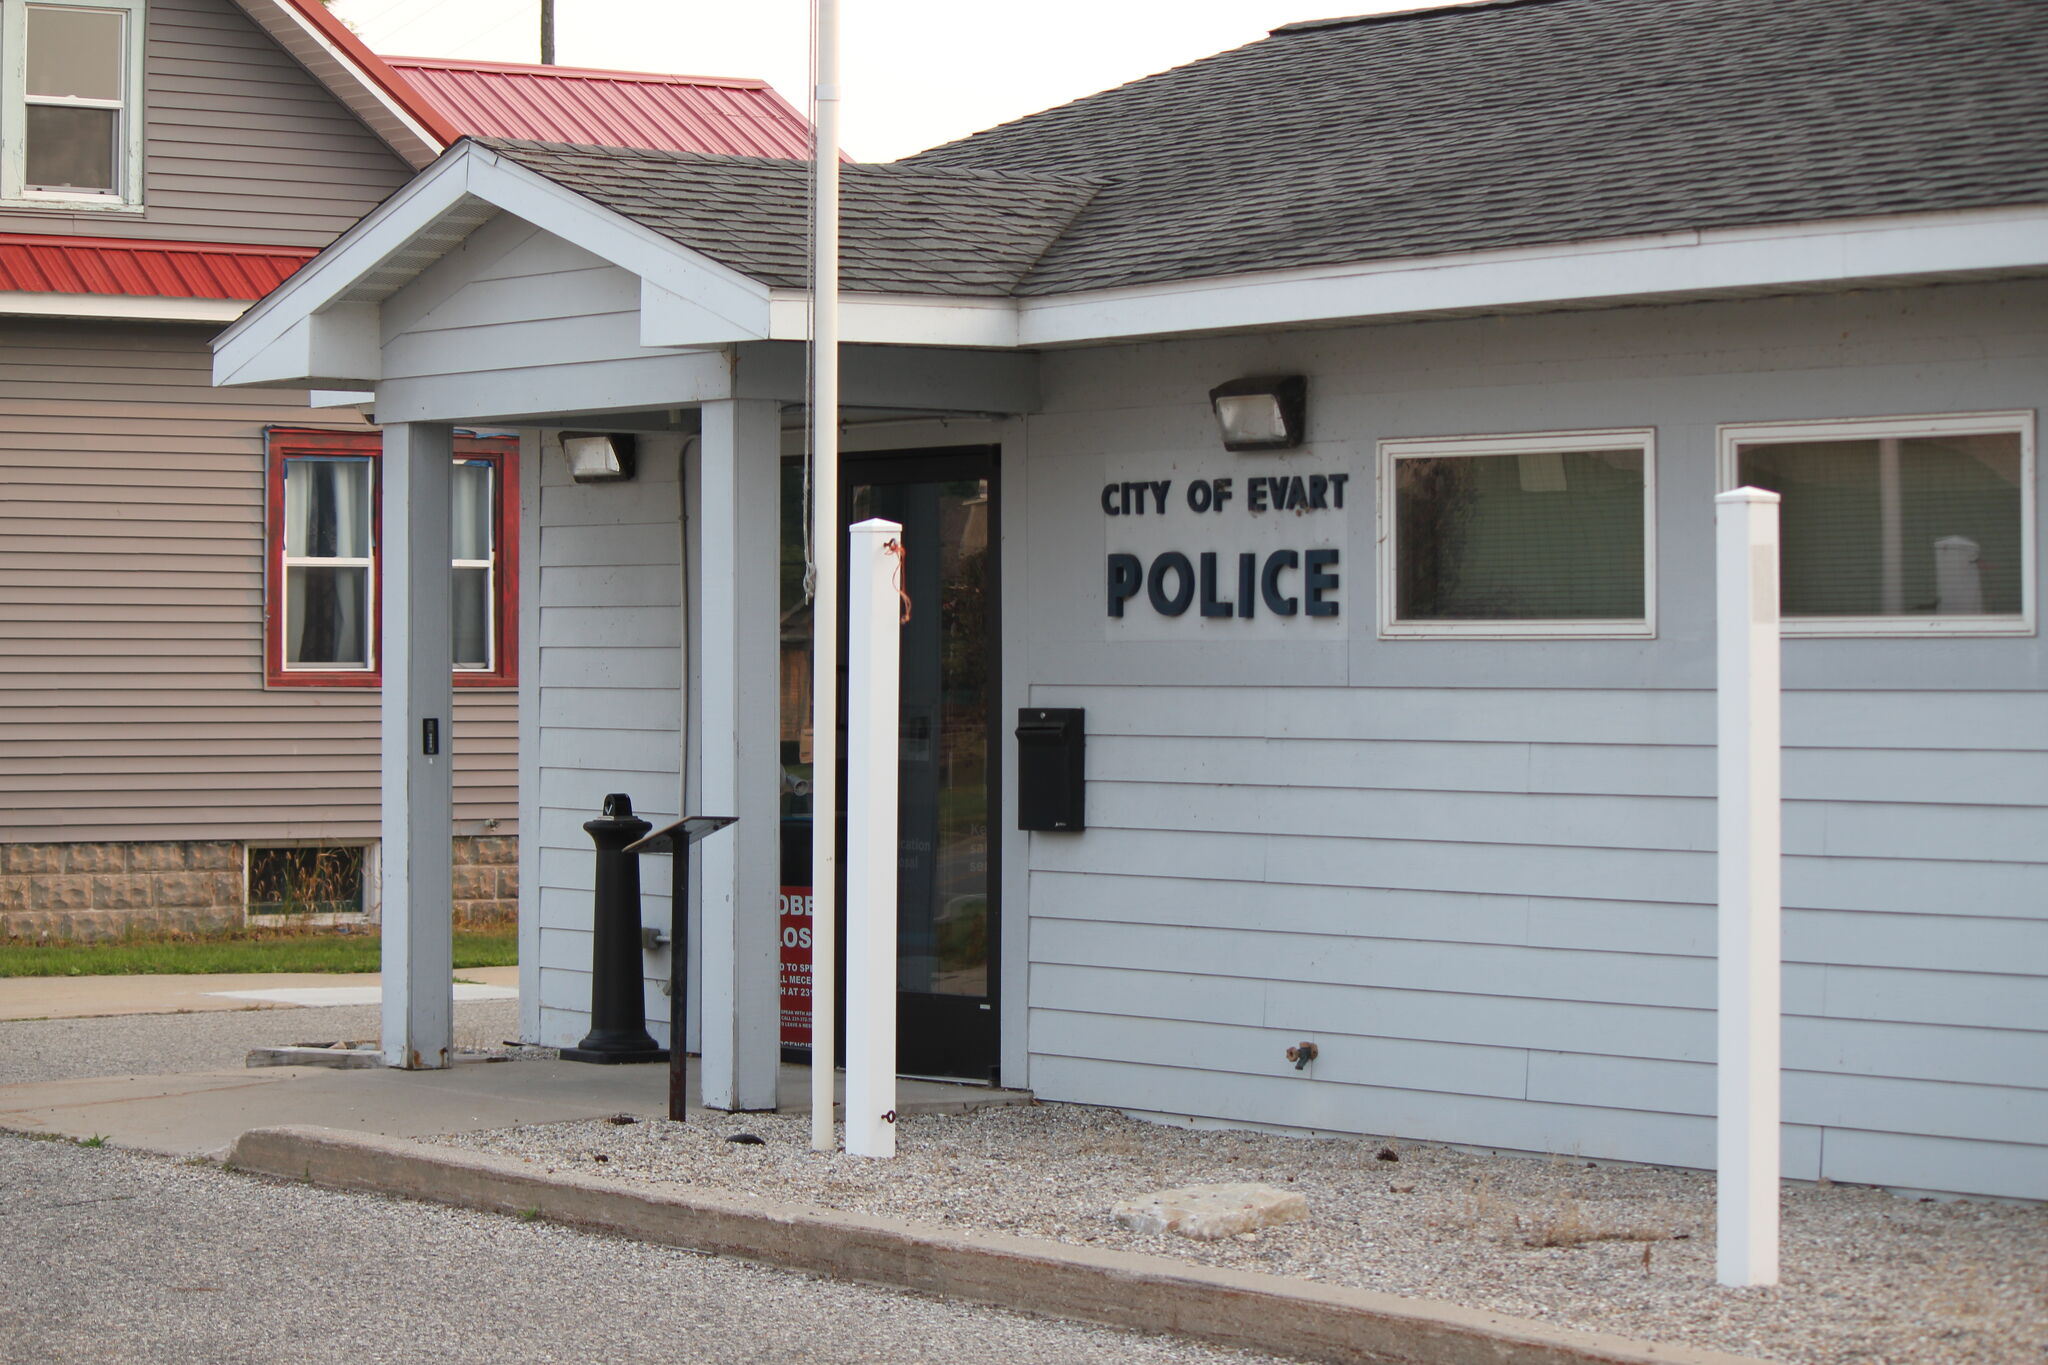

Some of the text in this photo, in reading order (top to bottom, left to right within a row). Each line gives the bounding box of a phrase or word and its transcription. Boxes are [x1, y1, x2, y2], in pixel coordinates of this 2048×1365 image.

[1101, 473, 1349, 516] CITY OF EVART
[1107, 548, 1340, 619] POLICE
[787, 963, 798, 971] TO
[788, 987, 799, 996] AT
